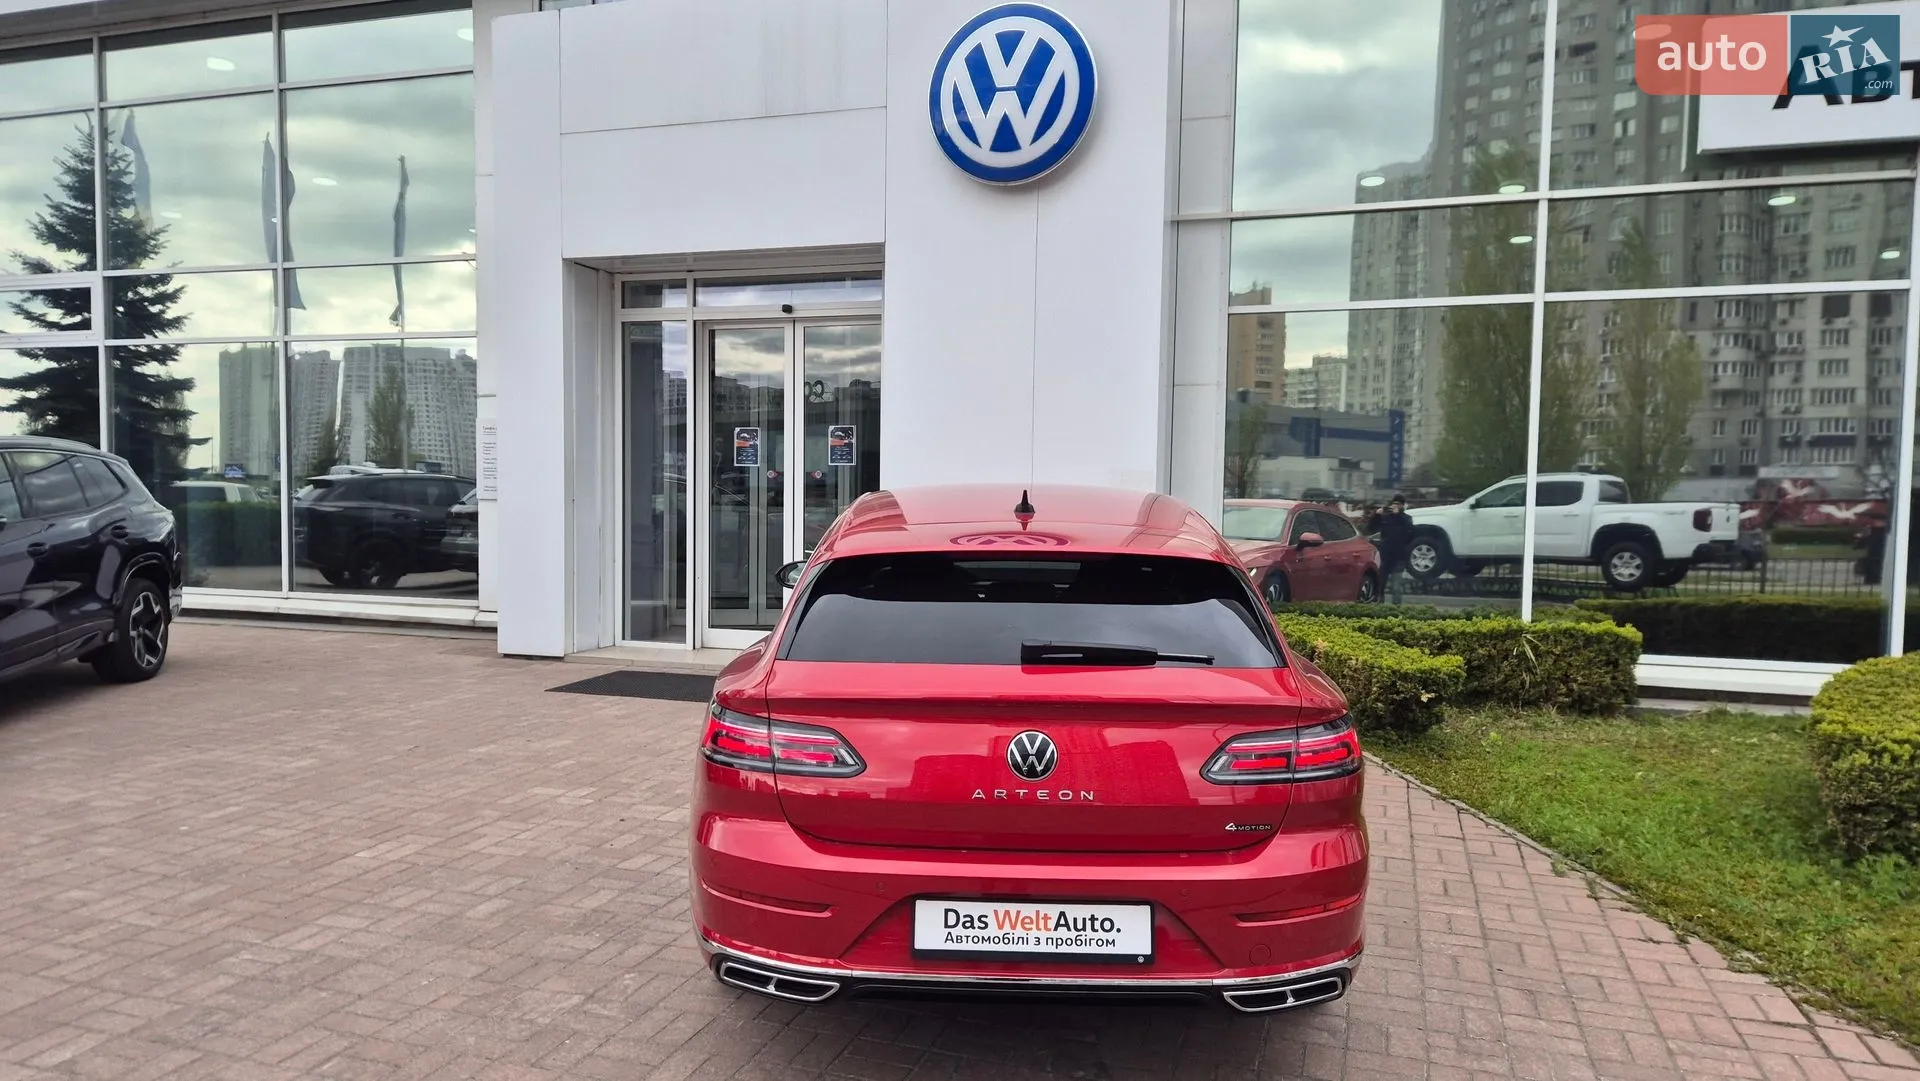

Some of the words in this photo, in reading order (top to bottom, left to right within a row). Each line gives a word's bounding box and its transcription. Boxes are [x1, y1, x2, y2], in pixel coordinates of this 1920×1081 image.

[971, 788, 1095, 801] ARTEON
[1225, 822, 1271, 832] 4MOTION
[943, 908, 989, 931] Das
[993, 909, 1121, 934] WeltAuto.
[944, 931, 1029, 946] Автомобілі
[1033, 937, 1041, 946] з
[1045, 934, 1116, 949] пробігом
